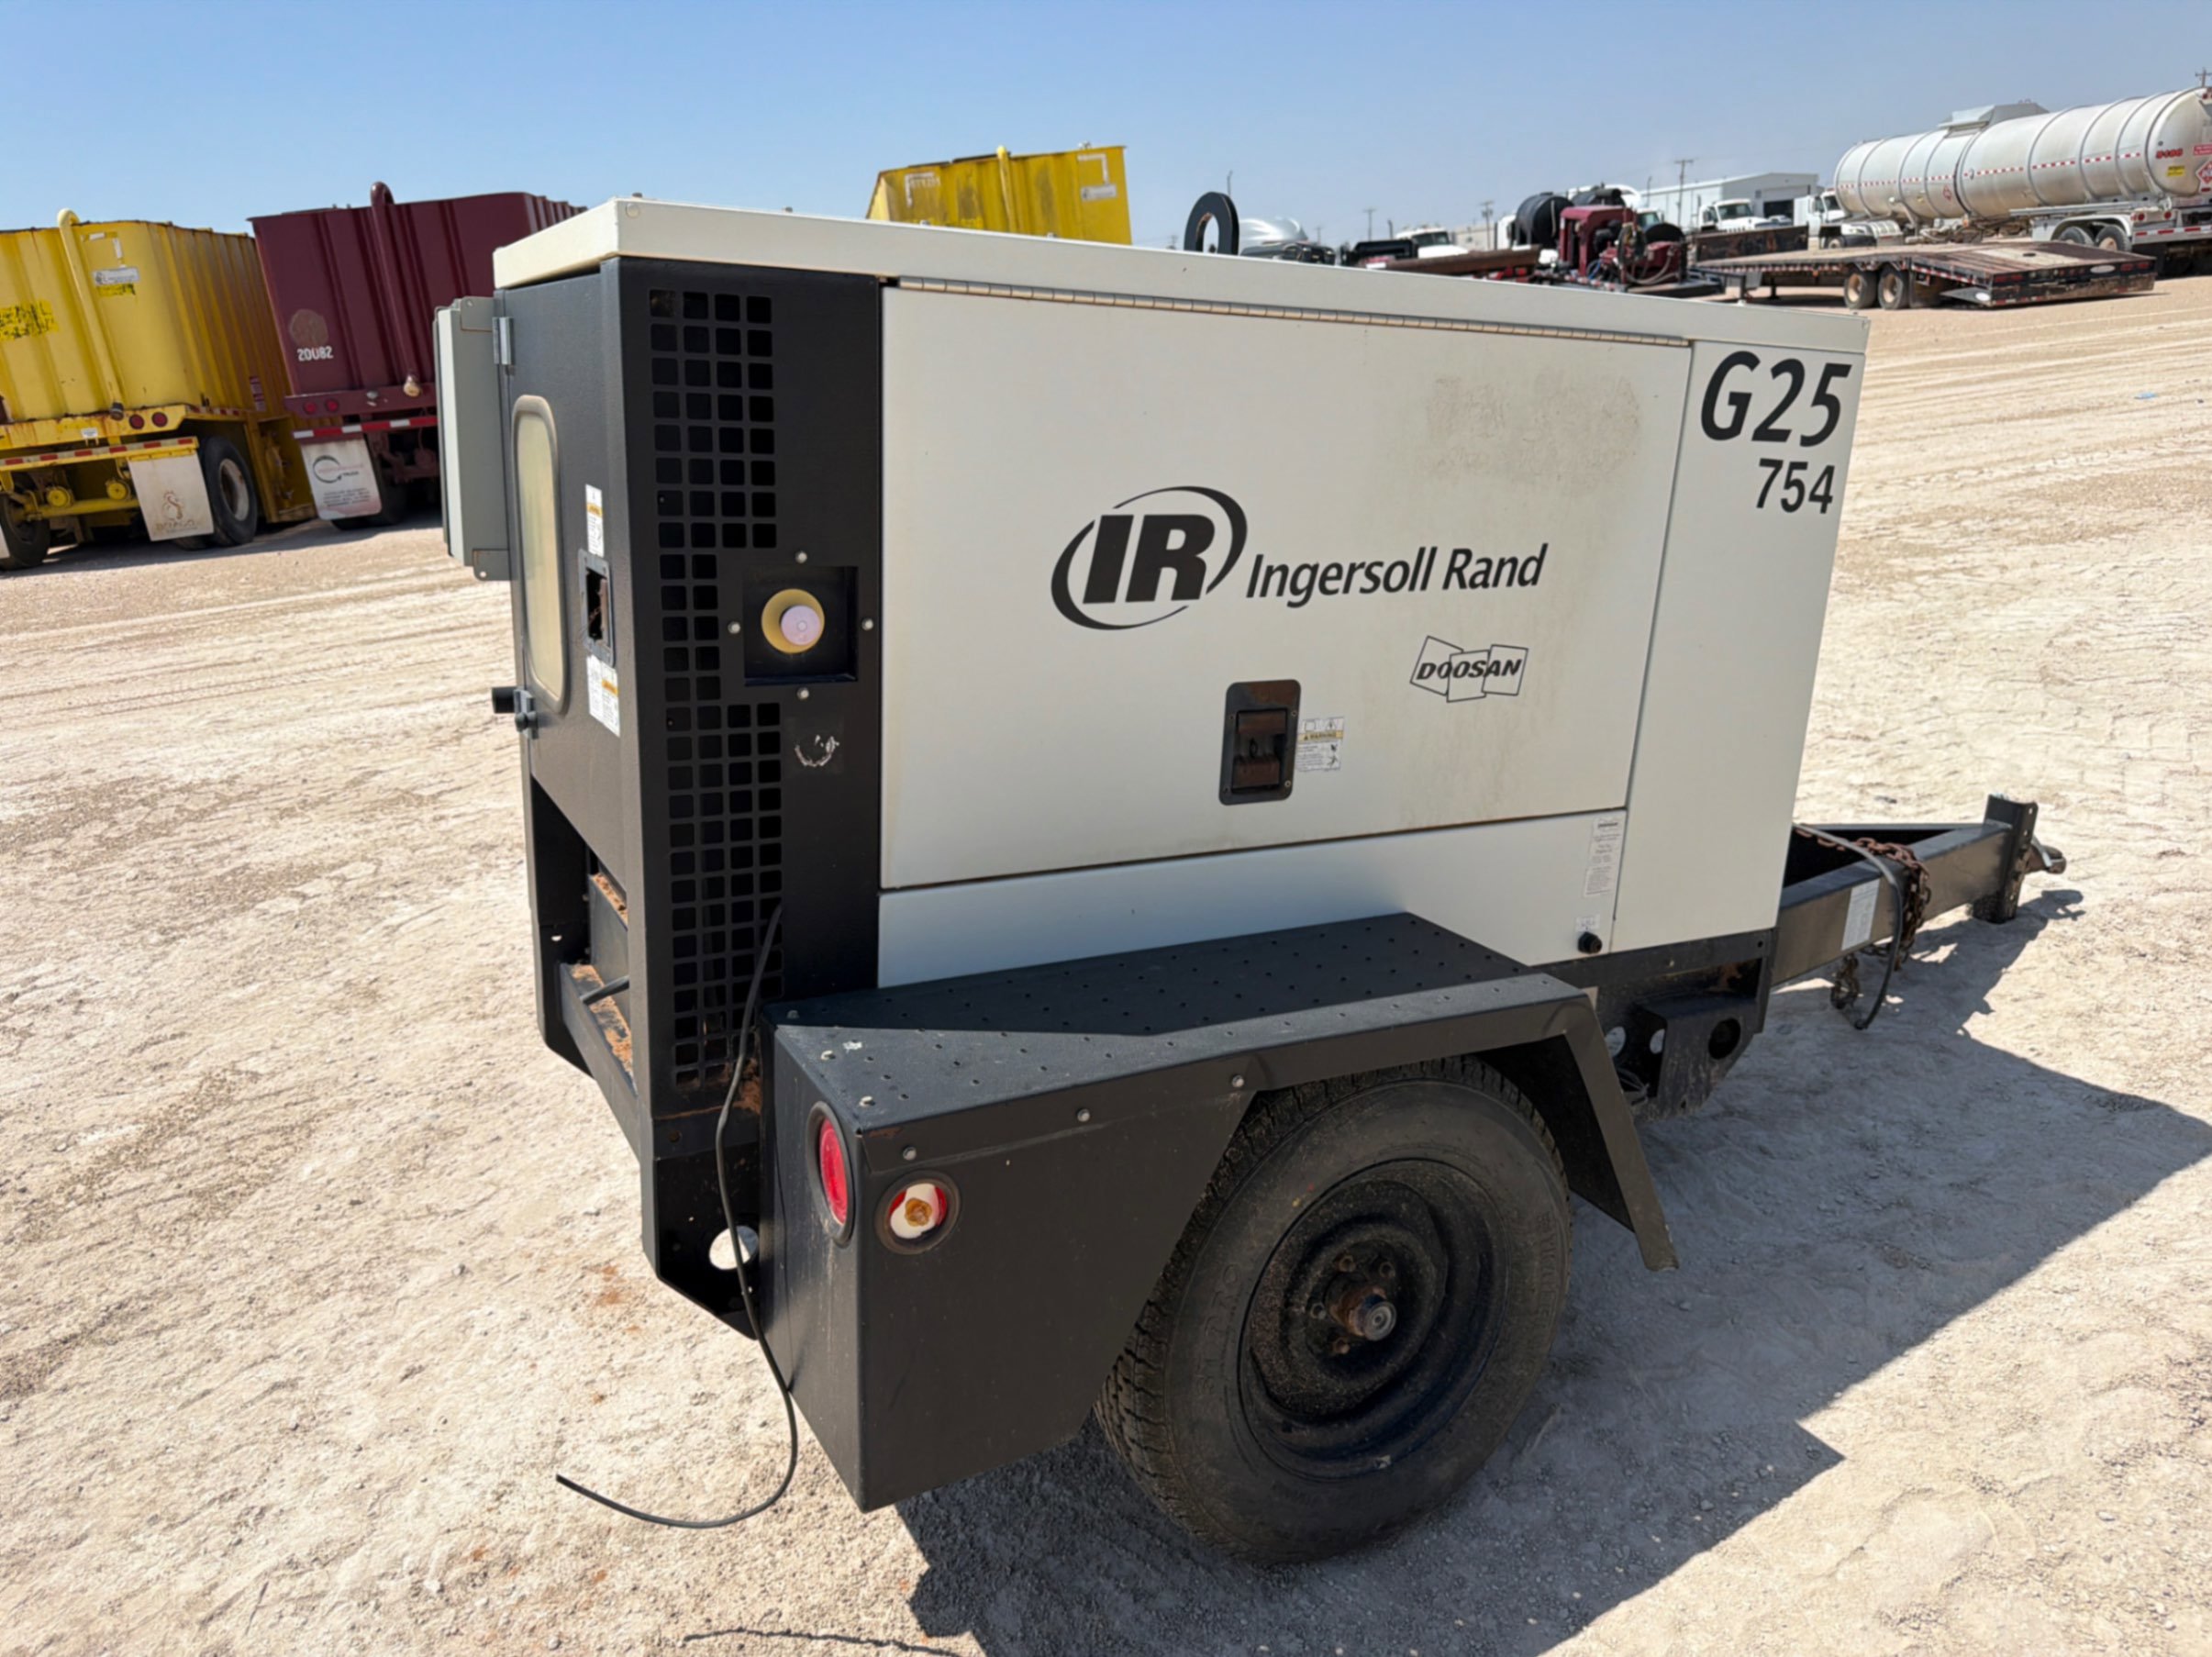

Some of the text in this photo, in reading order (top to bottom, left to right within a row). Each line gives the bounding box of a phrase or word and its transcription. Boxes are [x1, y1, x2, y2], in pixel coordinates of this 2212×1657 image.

[1701, 350, 1852, 448] G25
[1755, 457, 1836, 514] 754
[1083, 514, 1216, 605] IR
[1246, 543, 1549, 608] Ingersoll Rand
[1416, 658, 1523, 681] DOOSAN
